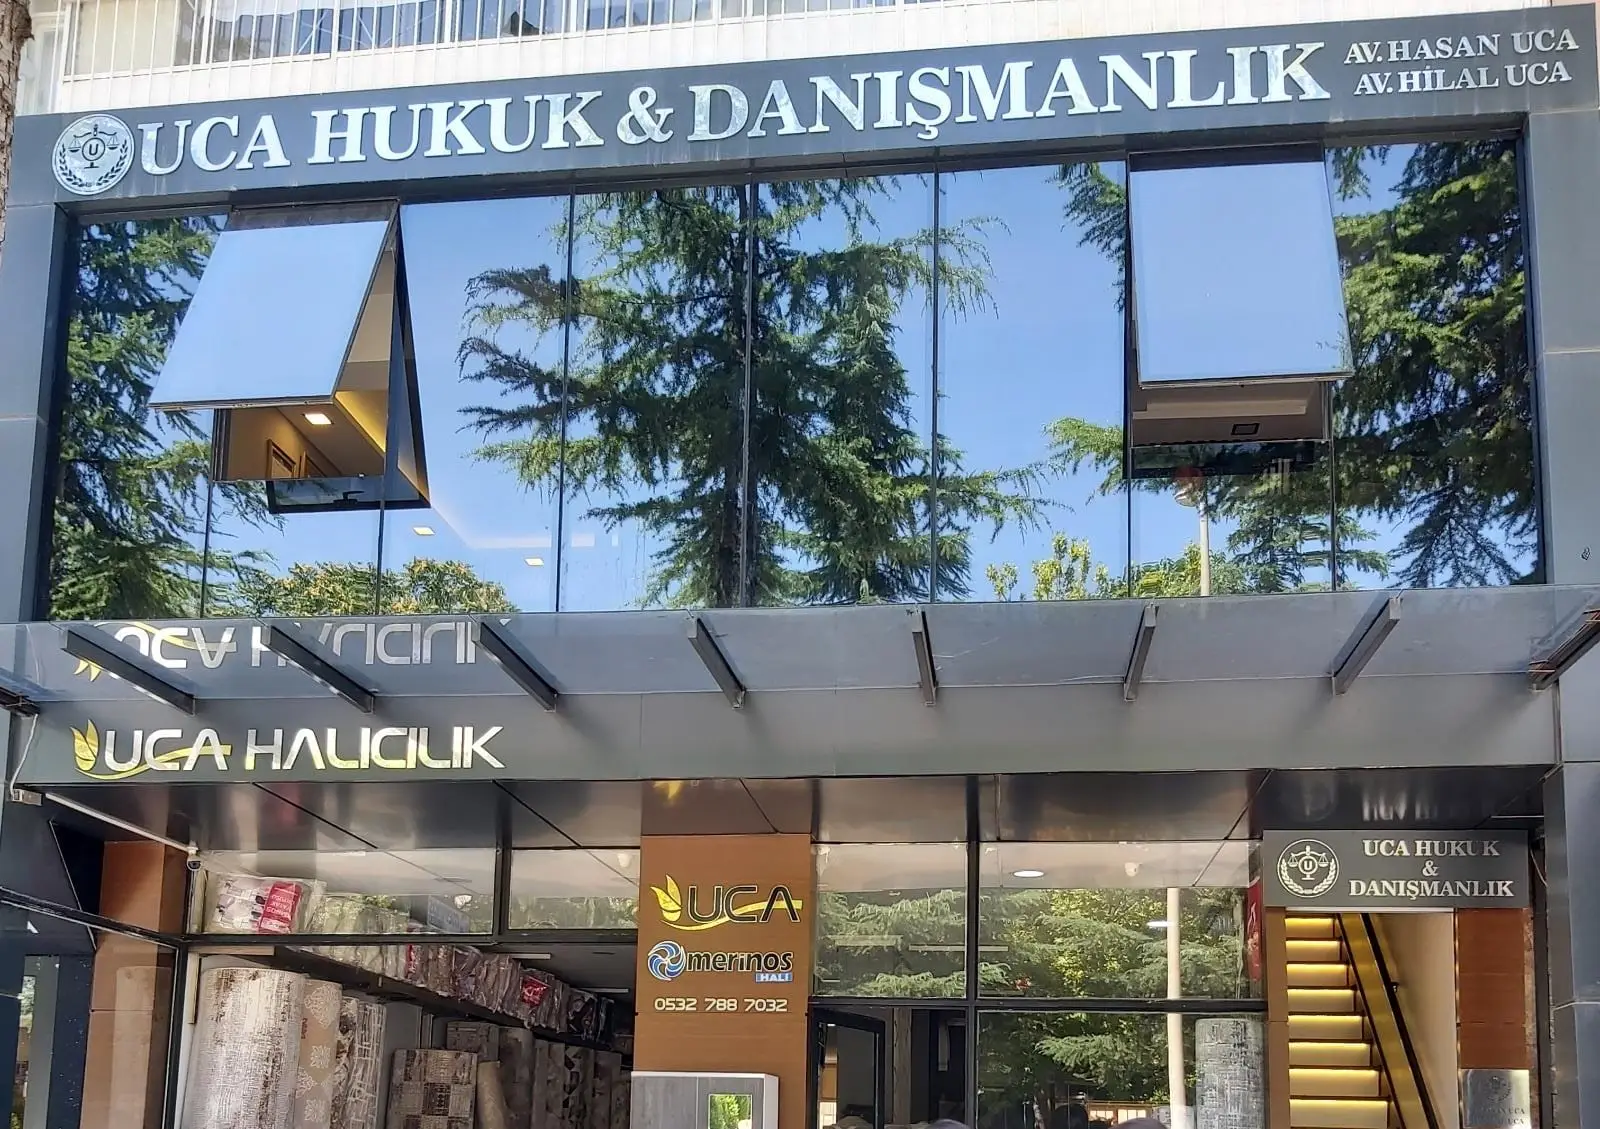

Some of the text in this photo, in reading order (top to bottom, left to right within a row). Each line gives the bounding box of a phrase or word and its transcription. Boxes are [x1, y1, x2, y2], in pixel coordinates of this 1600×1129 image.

[1387, 34, 1500, 62] HASAN
[1510, 28, 1580, 54] UCA
[1397, 65, 1500, 93] HİLAL
[1504, 61, 1573, 87] UCA
[137, 41, 1331, 176] UCA HUKUK & DANIŞMANLIK
[104, 726, 507, 771] UCA HALICILIK
[1362, 839, 1499, 857] UCA HUKUK
[1422, 860, 1439, 876] &
[1348, 880, 1515, 900] DANIŞMANLIK
[687, 884, 801, 923] UCA
[687, 951, 794, 972] merinos
[654, 998, 788, 1012] 0532 788 7032
